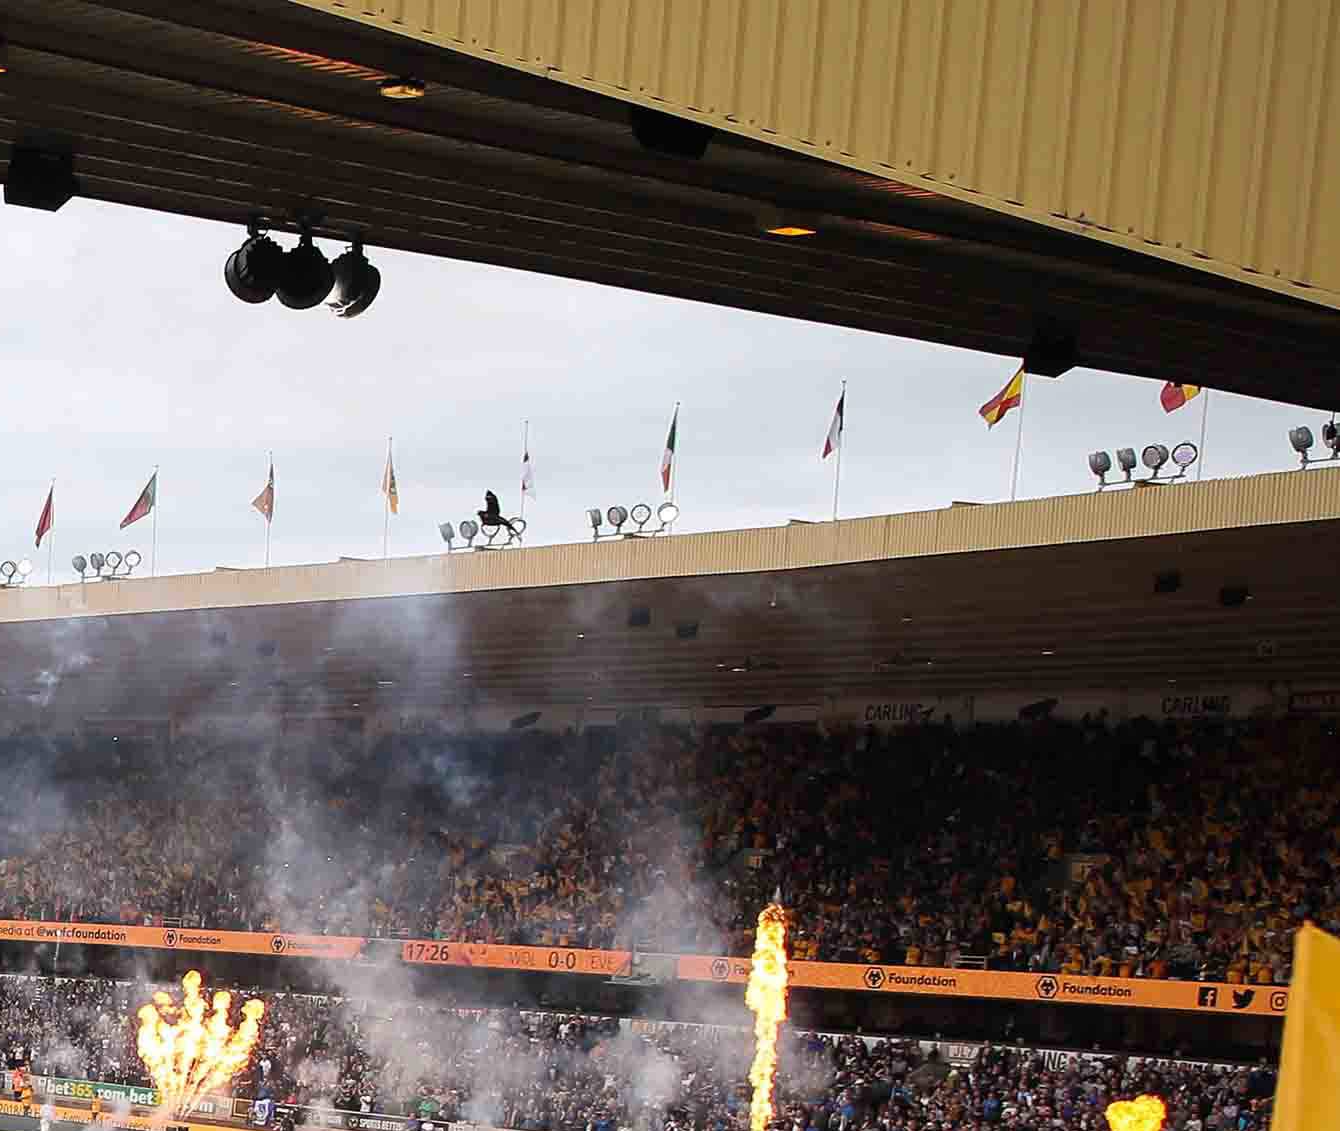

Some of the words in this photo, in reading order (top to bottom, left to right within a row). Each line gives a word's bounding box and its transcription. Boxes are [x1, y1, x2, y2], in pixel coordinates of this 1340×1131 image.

[24, 927, 34, 936] at
[179, 935, 222, 945] Foundation
[408, 944, 449, 961] 17:26
[548, 951, 577, 969] 0-0
[591, 956, 617, 970] EVE
[888, 972, 957, 988] Foundation
[1063, 982, 1132, 997] Foundation
[47, 1079, 125, 1099] bet365com
[359, 1118, 381, 1130] SPORTS
